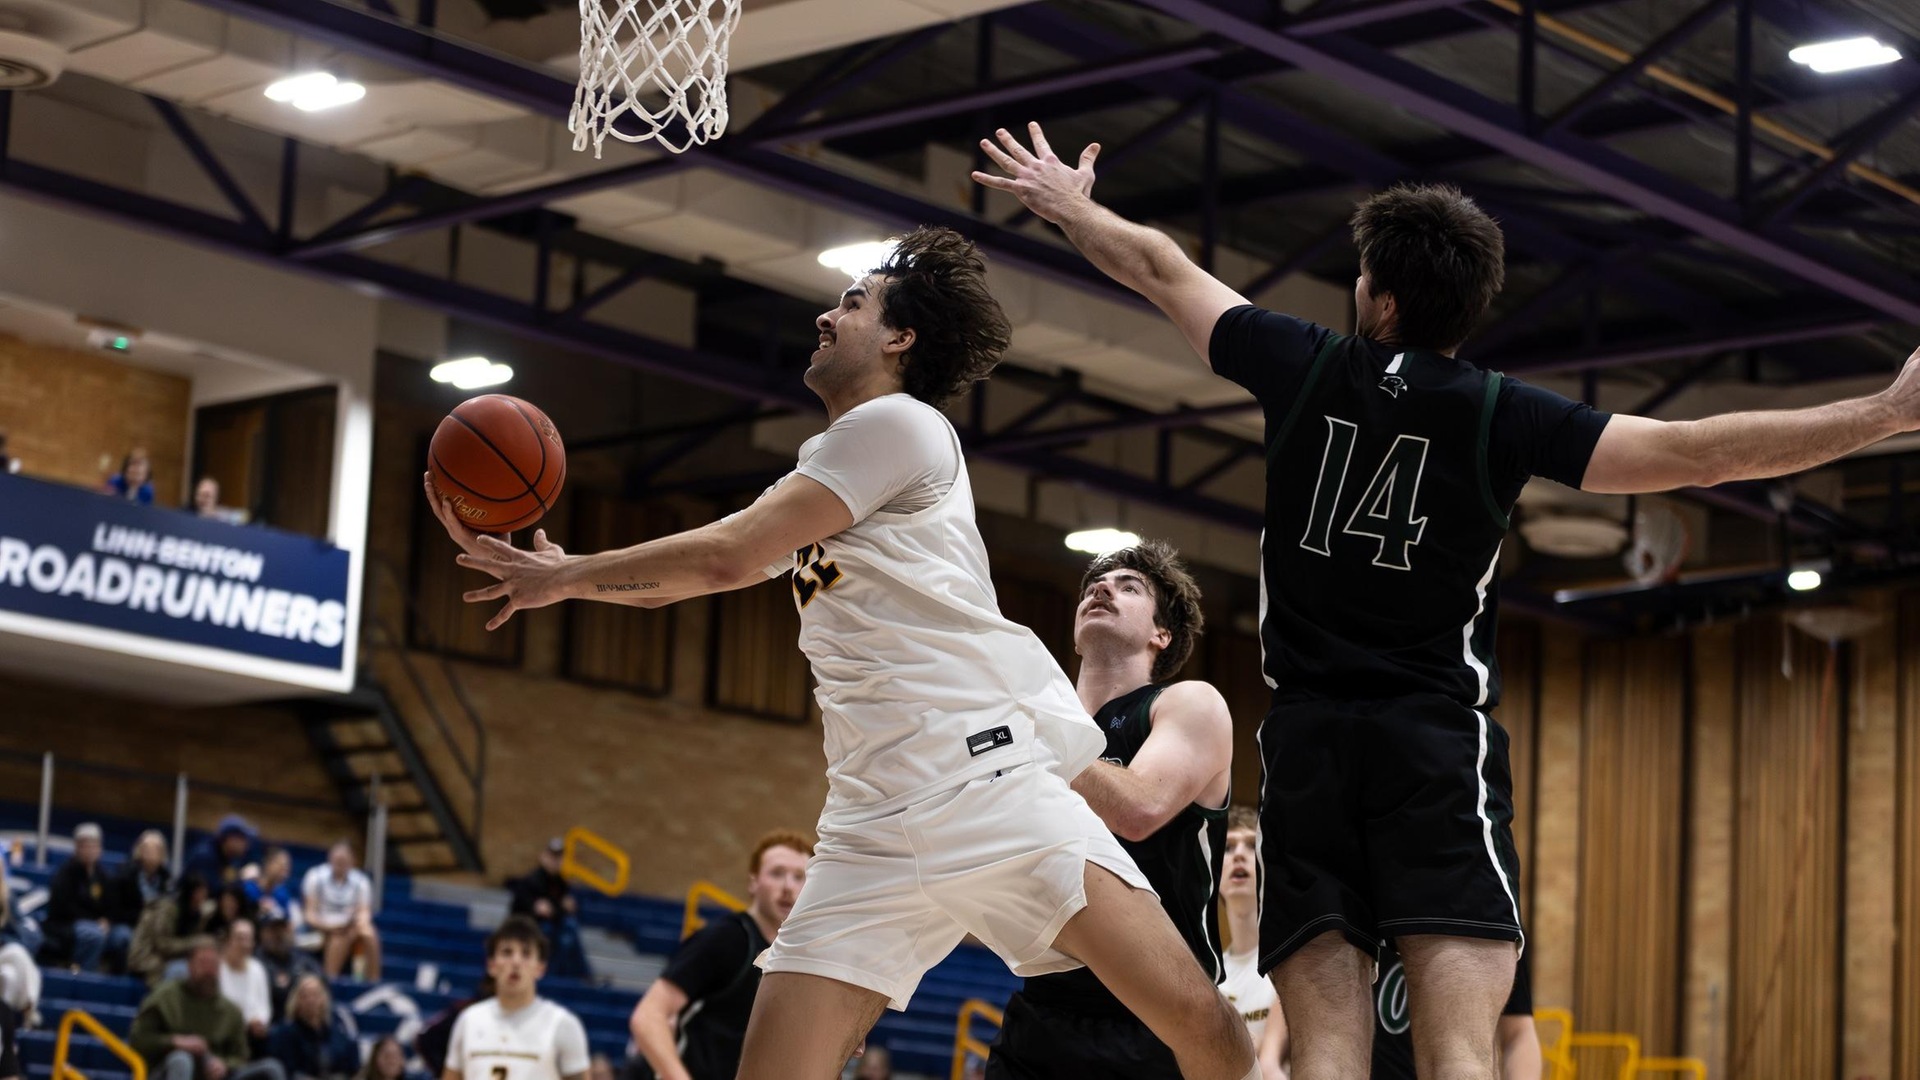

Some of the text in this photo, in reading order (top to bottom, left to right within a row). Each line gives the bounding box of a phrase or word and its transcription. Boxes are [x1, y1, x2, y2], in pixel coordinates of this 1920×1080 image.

[1299, 415, 1430, 571] 14
[0, 538, 346, 648] ROADRUNNERS
[93, 523, 264, 583] LINN-BENTON
[995, 731, 1008, 741] XL
